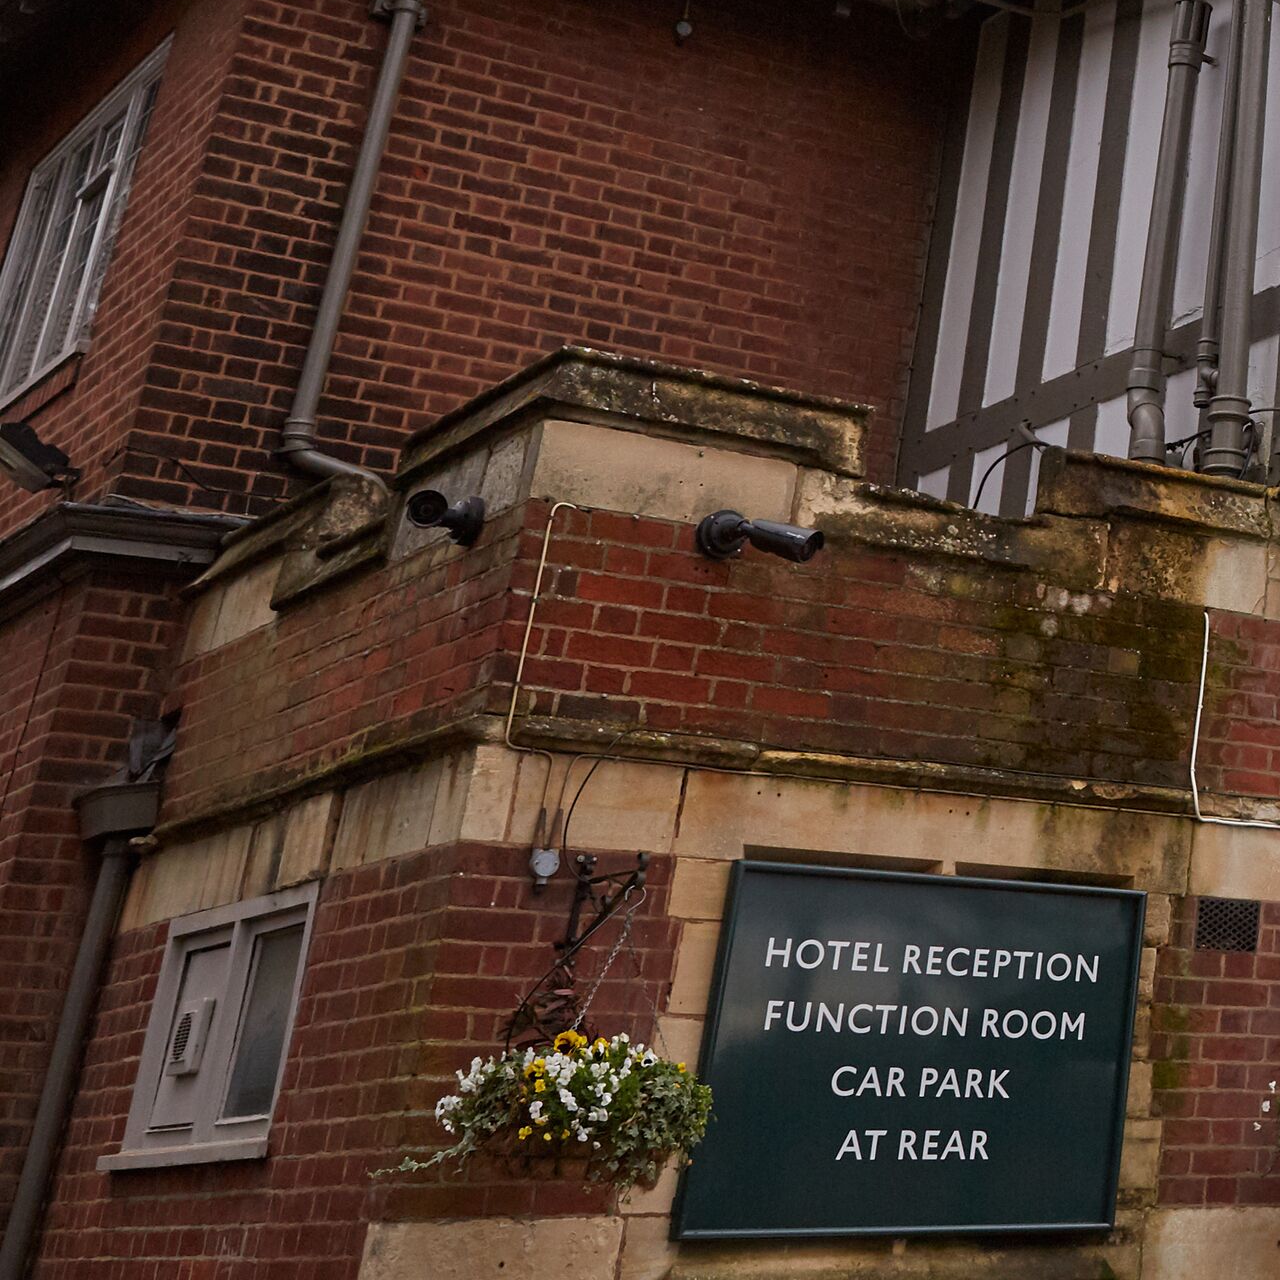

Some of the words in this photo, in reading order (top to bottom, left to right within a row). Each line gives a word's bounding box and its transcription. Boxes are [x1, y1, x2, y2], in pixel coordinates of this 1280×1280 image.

[764, 937, 889, 974] HOTEL
[902, 944, 1100, 983] RECEPTION
[763, 1000, 969, 1037] FUNCTION
[980, 1008, 1086, 1041] ROOM
[831, 1066, 906, 1098] CAR
[918, 1068, 1011, 1099] PARK
[835, 1129, 888, 1161] AT
[898, 1129, 990, 1161] REAR
